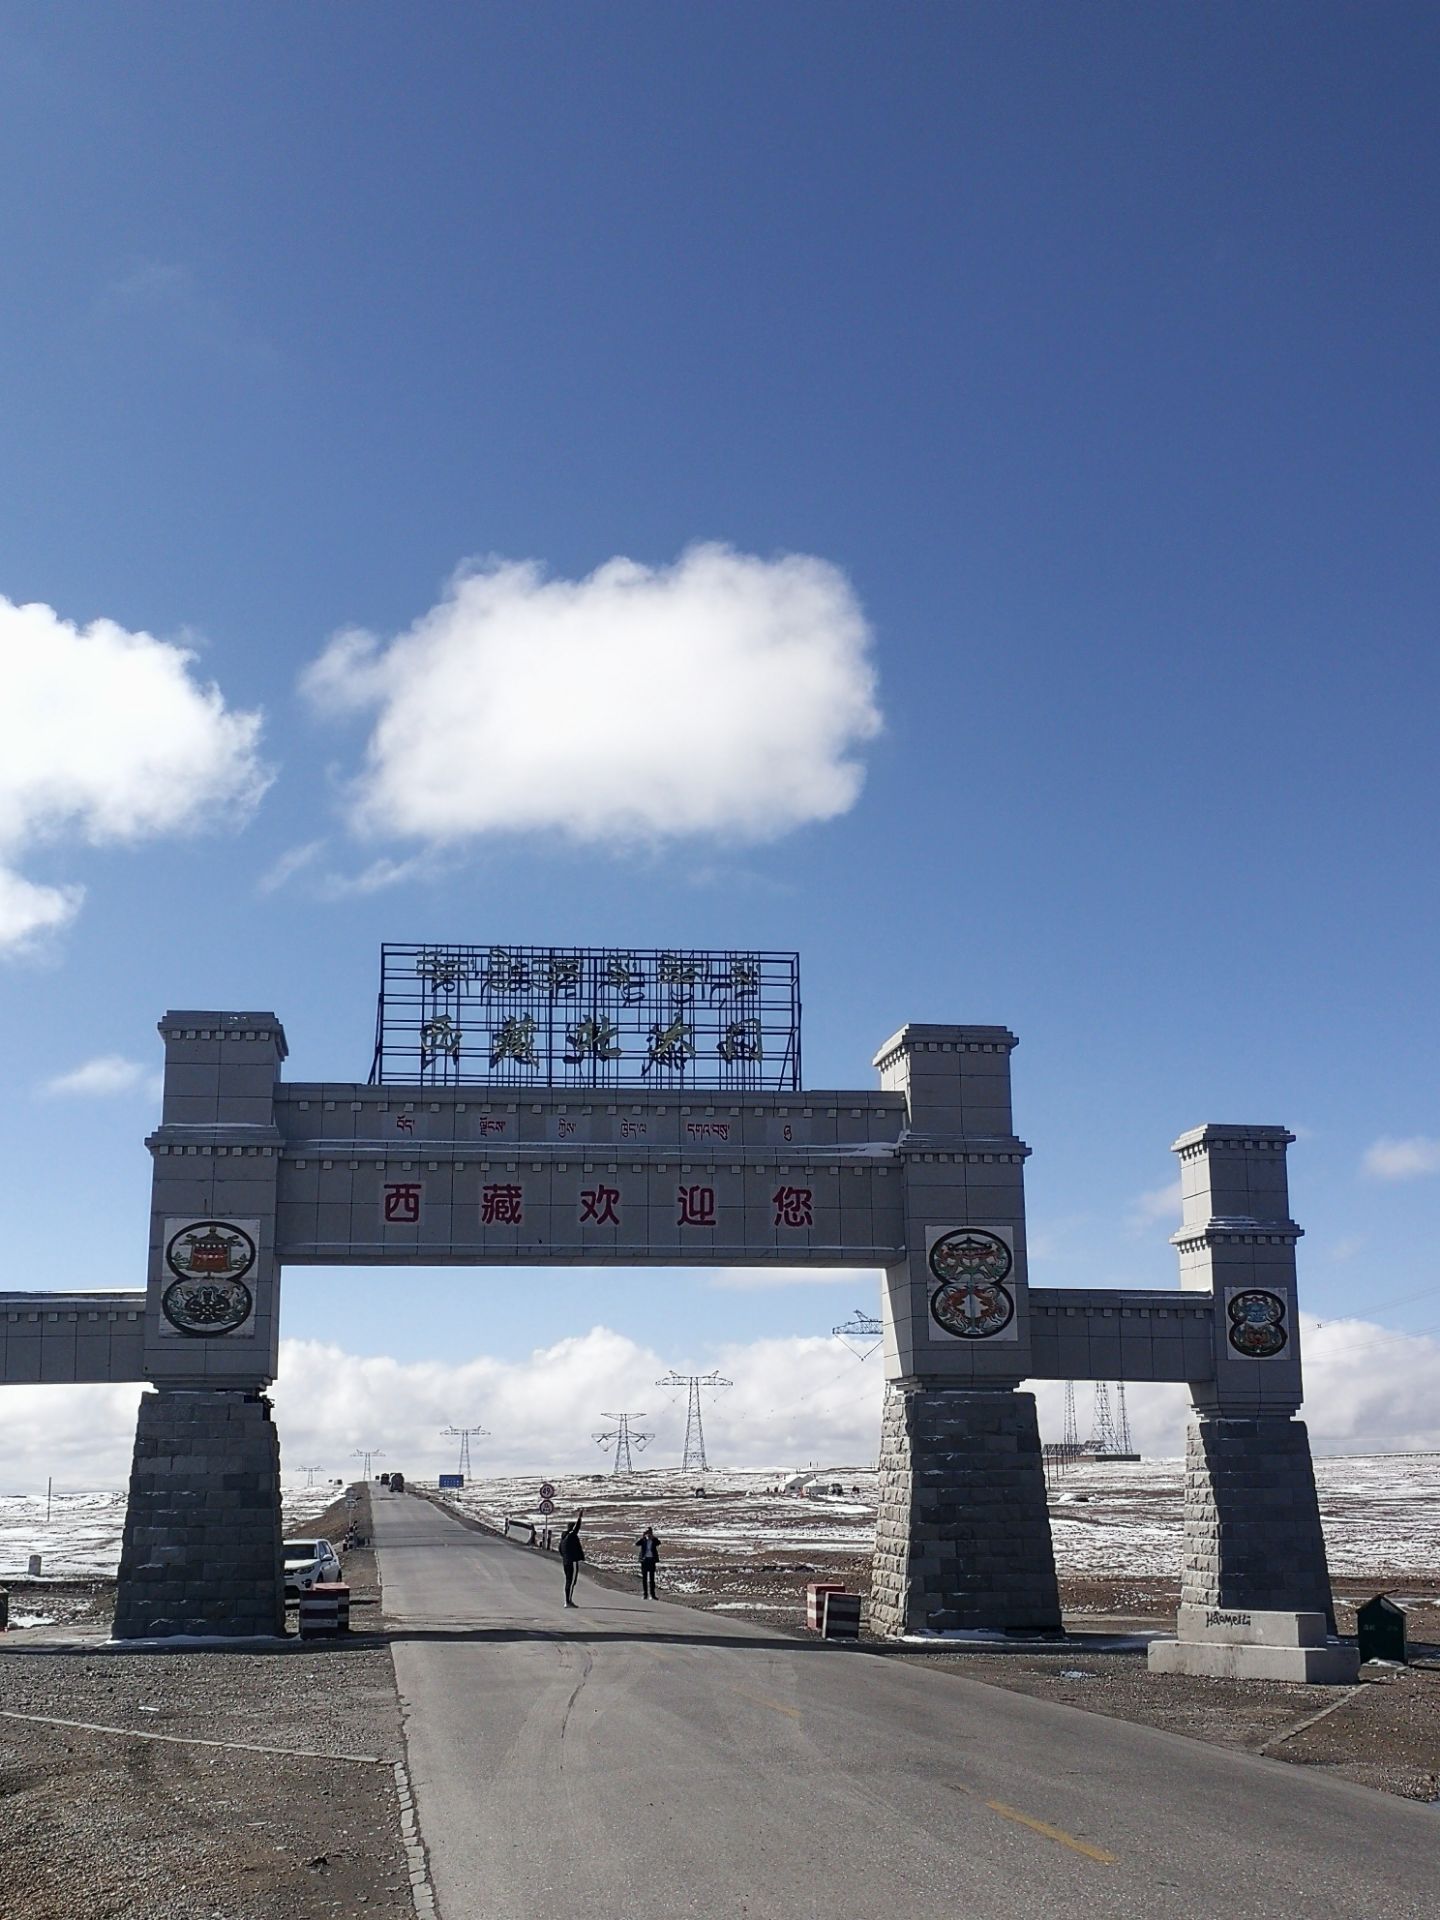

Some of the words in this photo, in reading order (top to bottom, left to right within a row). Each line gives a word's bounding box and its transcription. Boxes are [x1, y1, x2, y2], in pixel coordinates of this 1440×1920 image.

[383, 1183, 814, 1227] 西藏欢迎您
